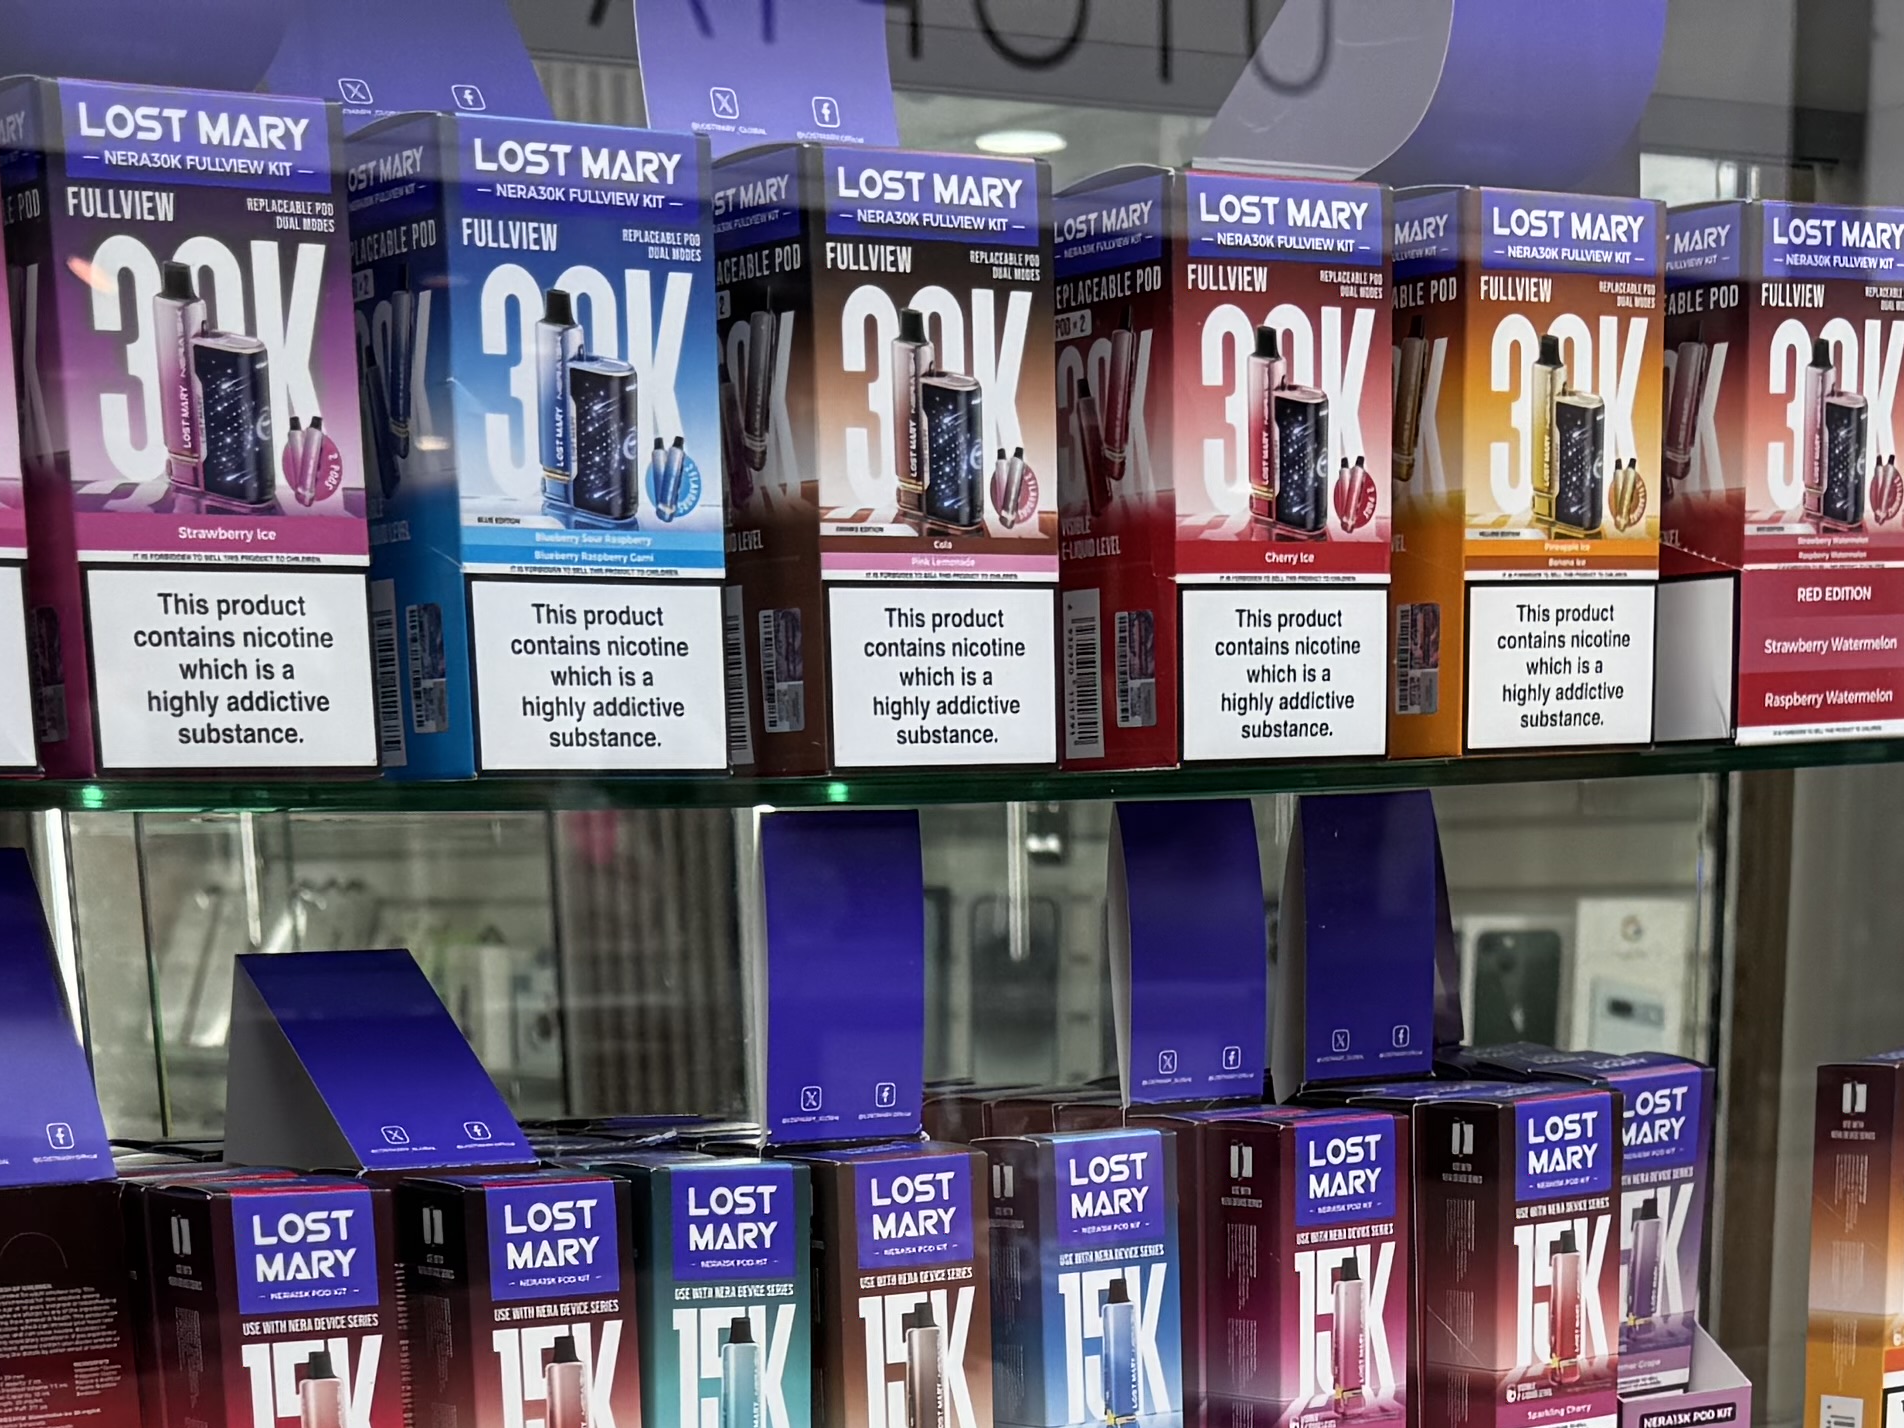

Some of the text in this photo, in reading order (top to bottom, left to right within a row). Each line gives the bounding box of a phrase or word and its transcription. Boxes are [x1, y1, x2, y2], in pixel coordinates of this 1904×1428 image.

[1798, 587, 1871, 601] RED EDITION
[1765, 636, 1897, 654] Strawberry Watermelon
